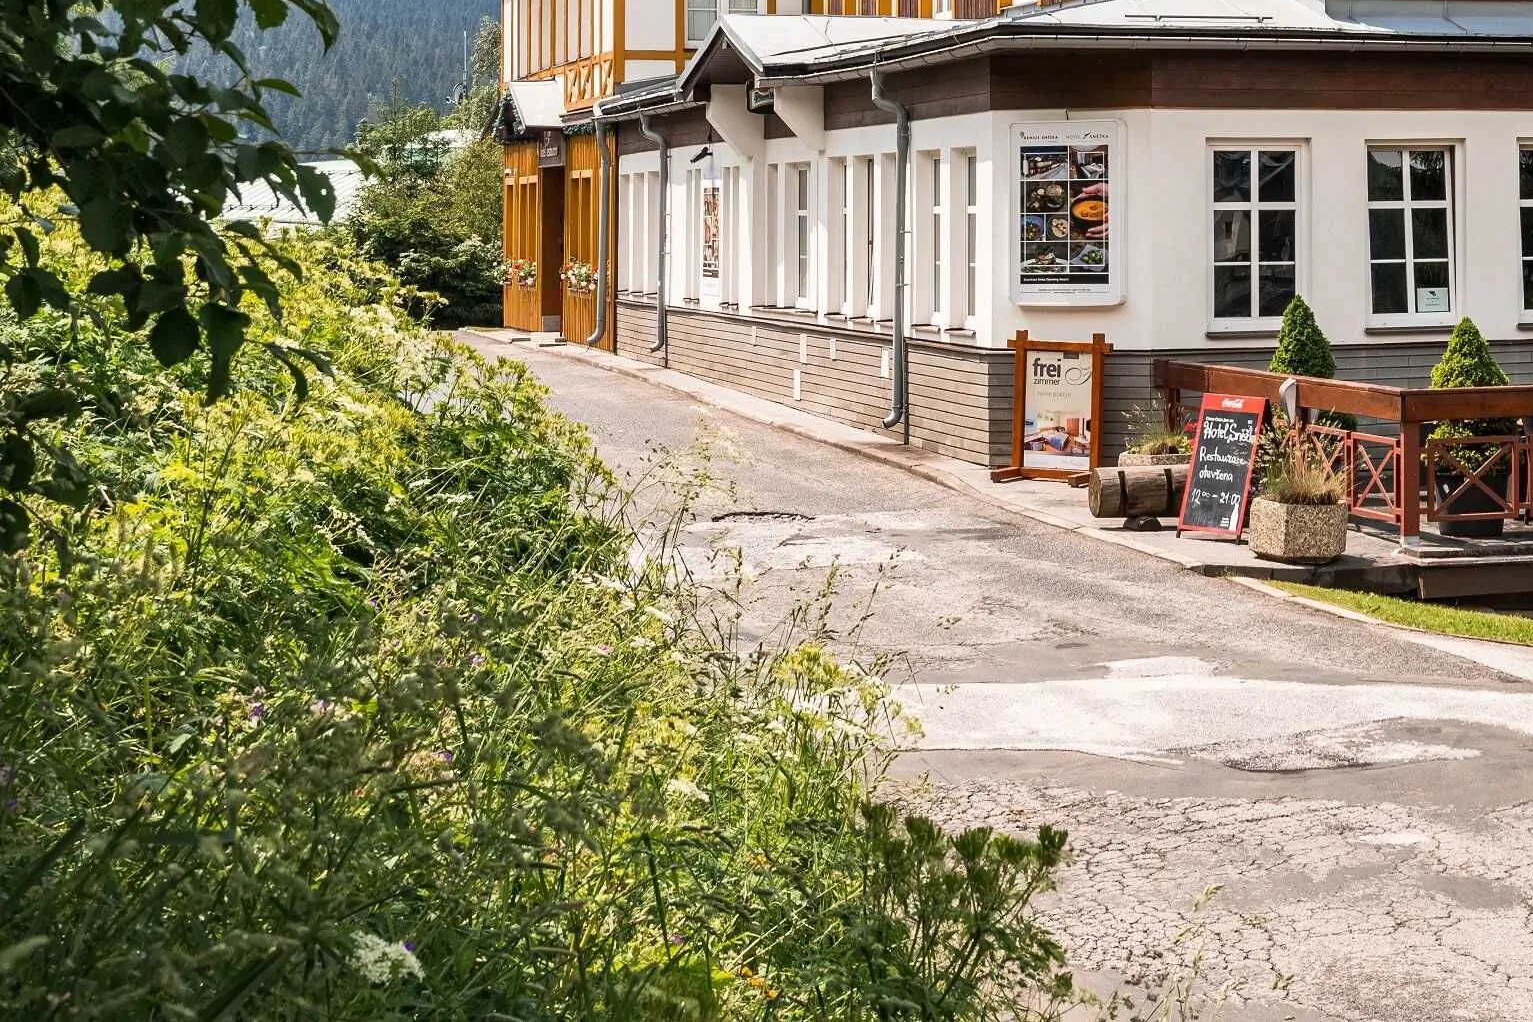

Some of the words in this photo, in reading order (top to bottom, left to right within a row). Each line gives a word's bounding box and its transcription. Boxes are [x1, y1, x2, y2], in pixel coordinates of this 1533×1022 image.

[1032, 357, 1062, 378] frei
[1033, 378, 1061, 386] zimmer
[1203, 420, 1230, 440] Hotel
[1219, 491, 1241, 506] 21:00
